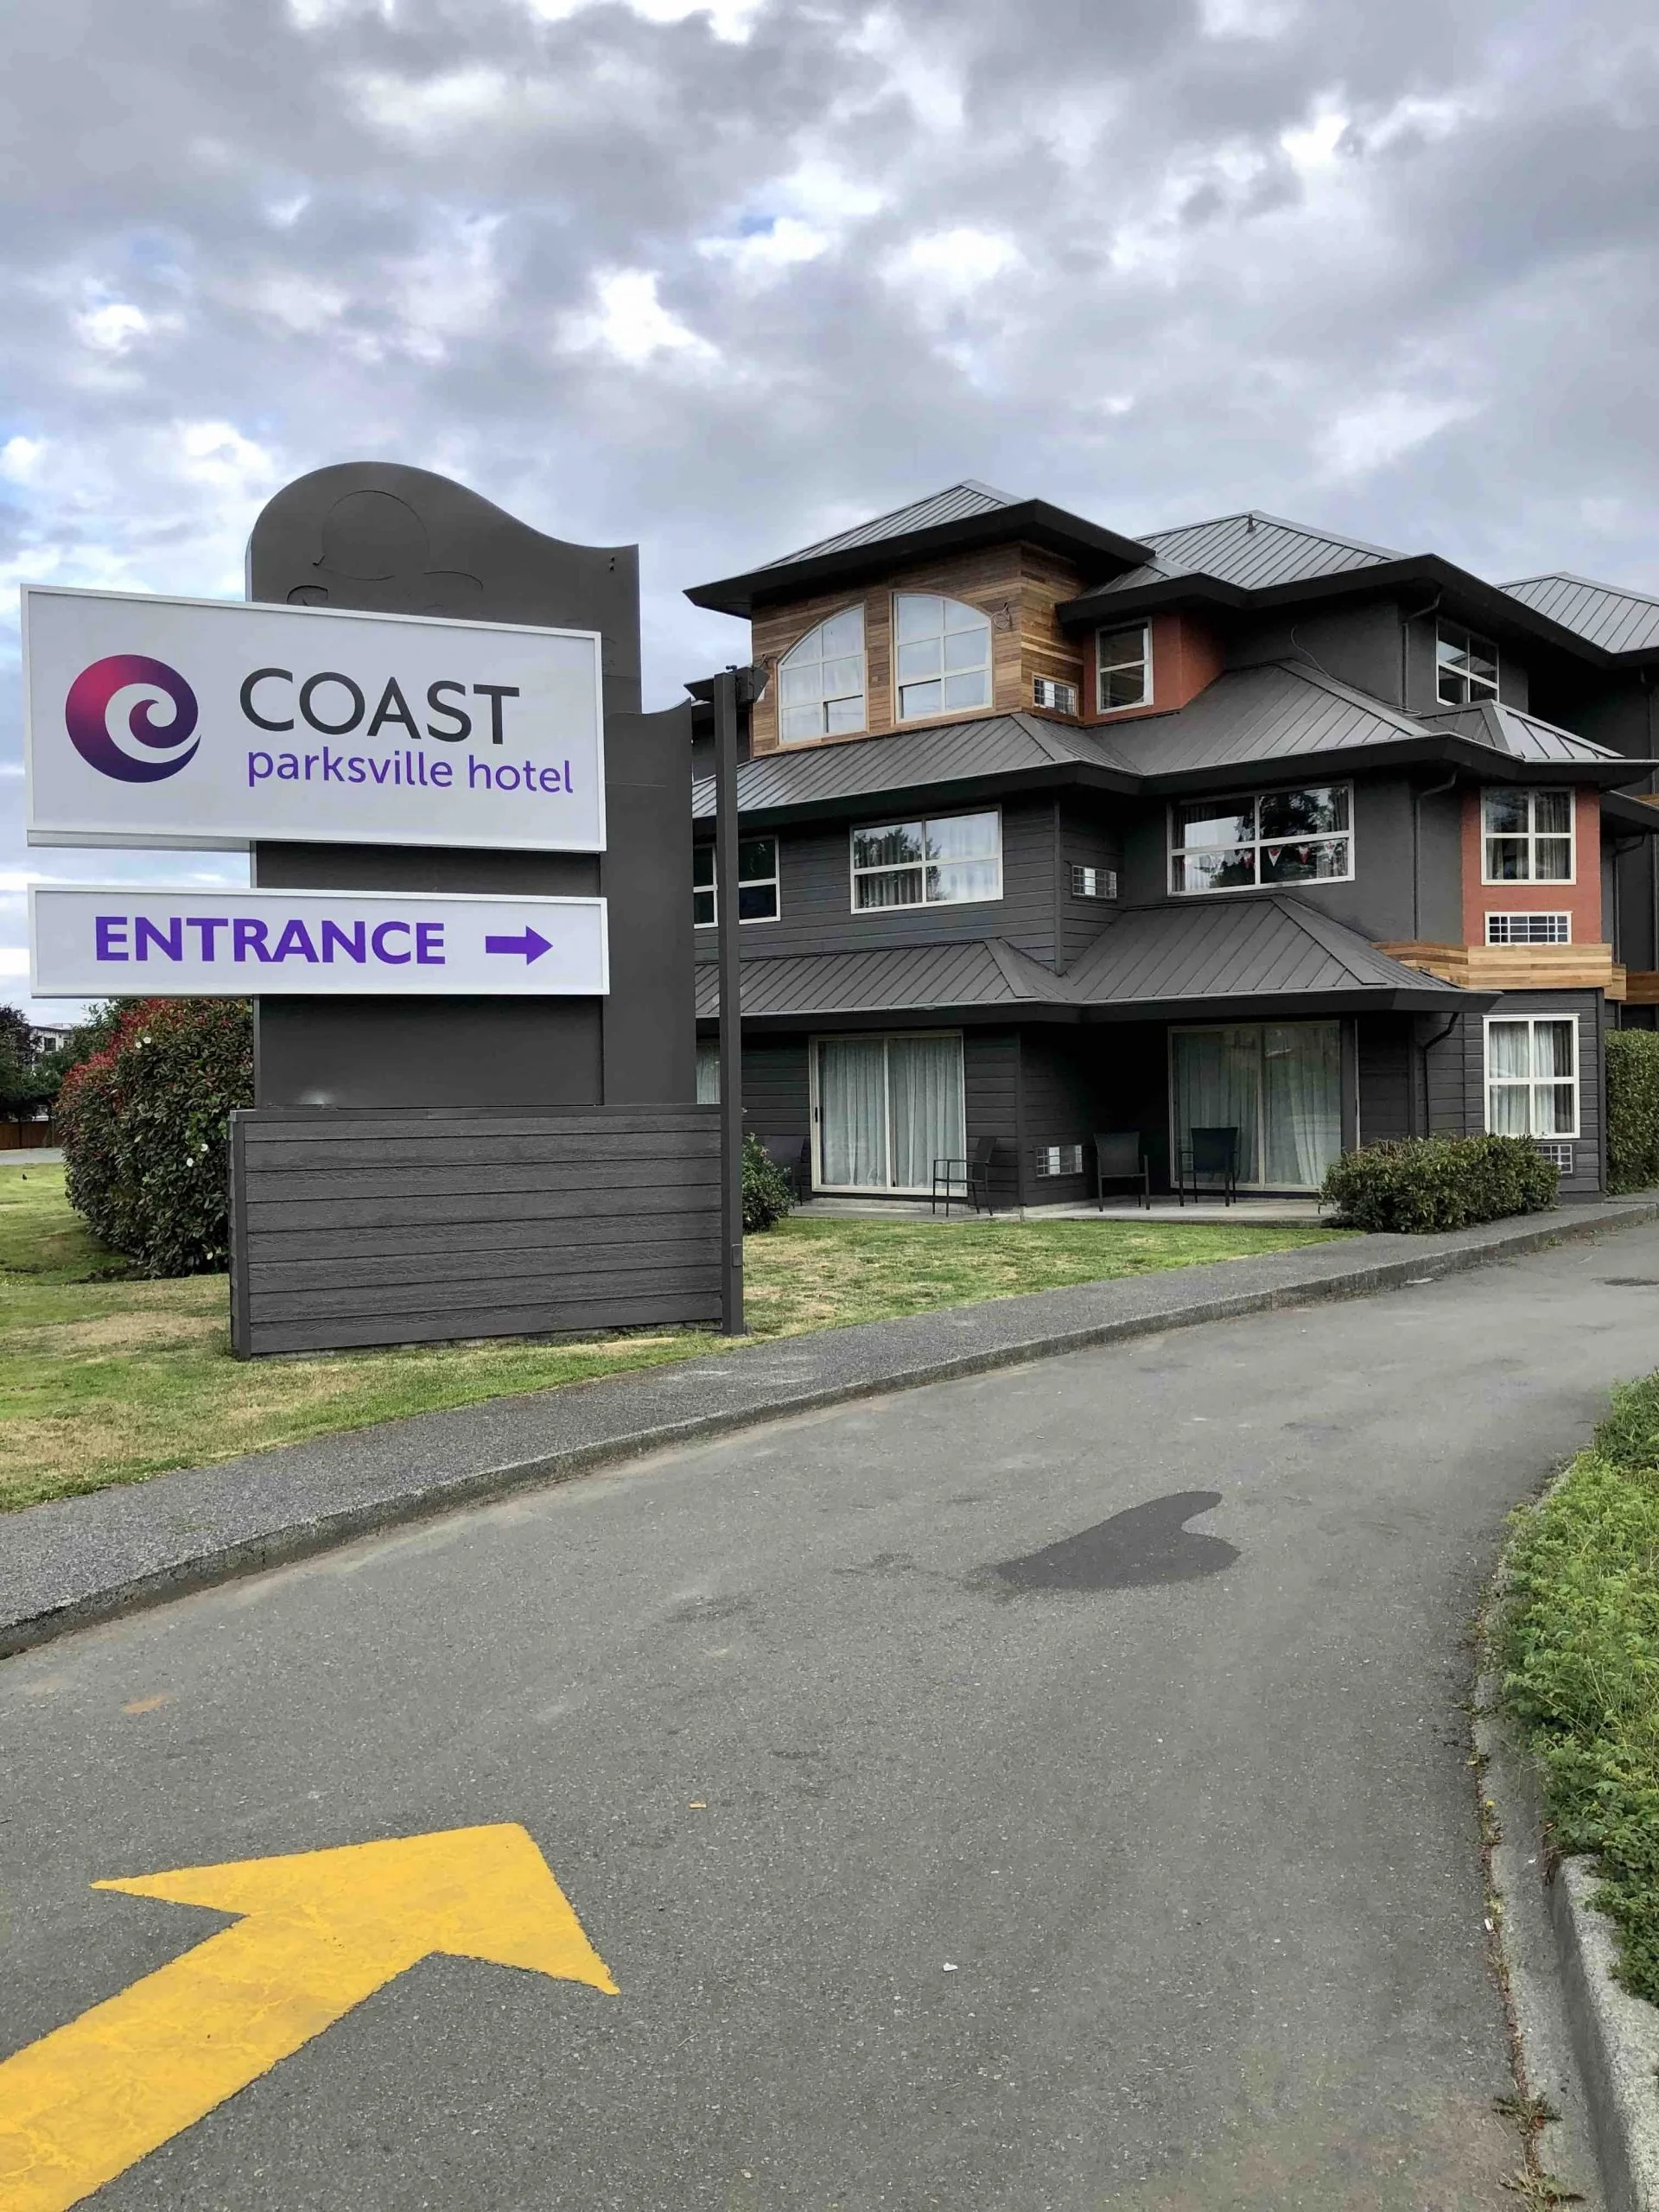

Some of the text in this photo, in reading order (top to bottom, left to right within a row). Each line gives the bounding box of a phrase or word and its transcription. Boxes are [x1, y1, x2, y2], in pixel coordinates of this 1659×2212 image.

[239, 667, 520, 745] COAST
[248, 746, 574, 793] parksville hotel
[95, 916, 446, 965] ENTRANCE
